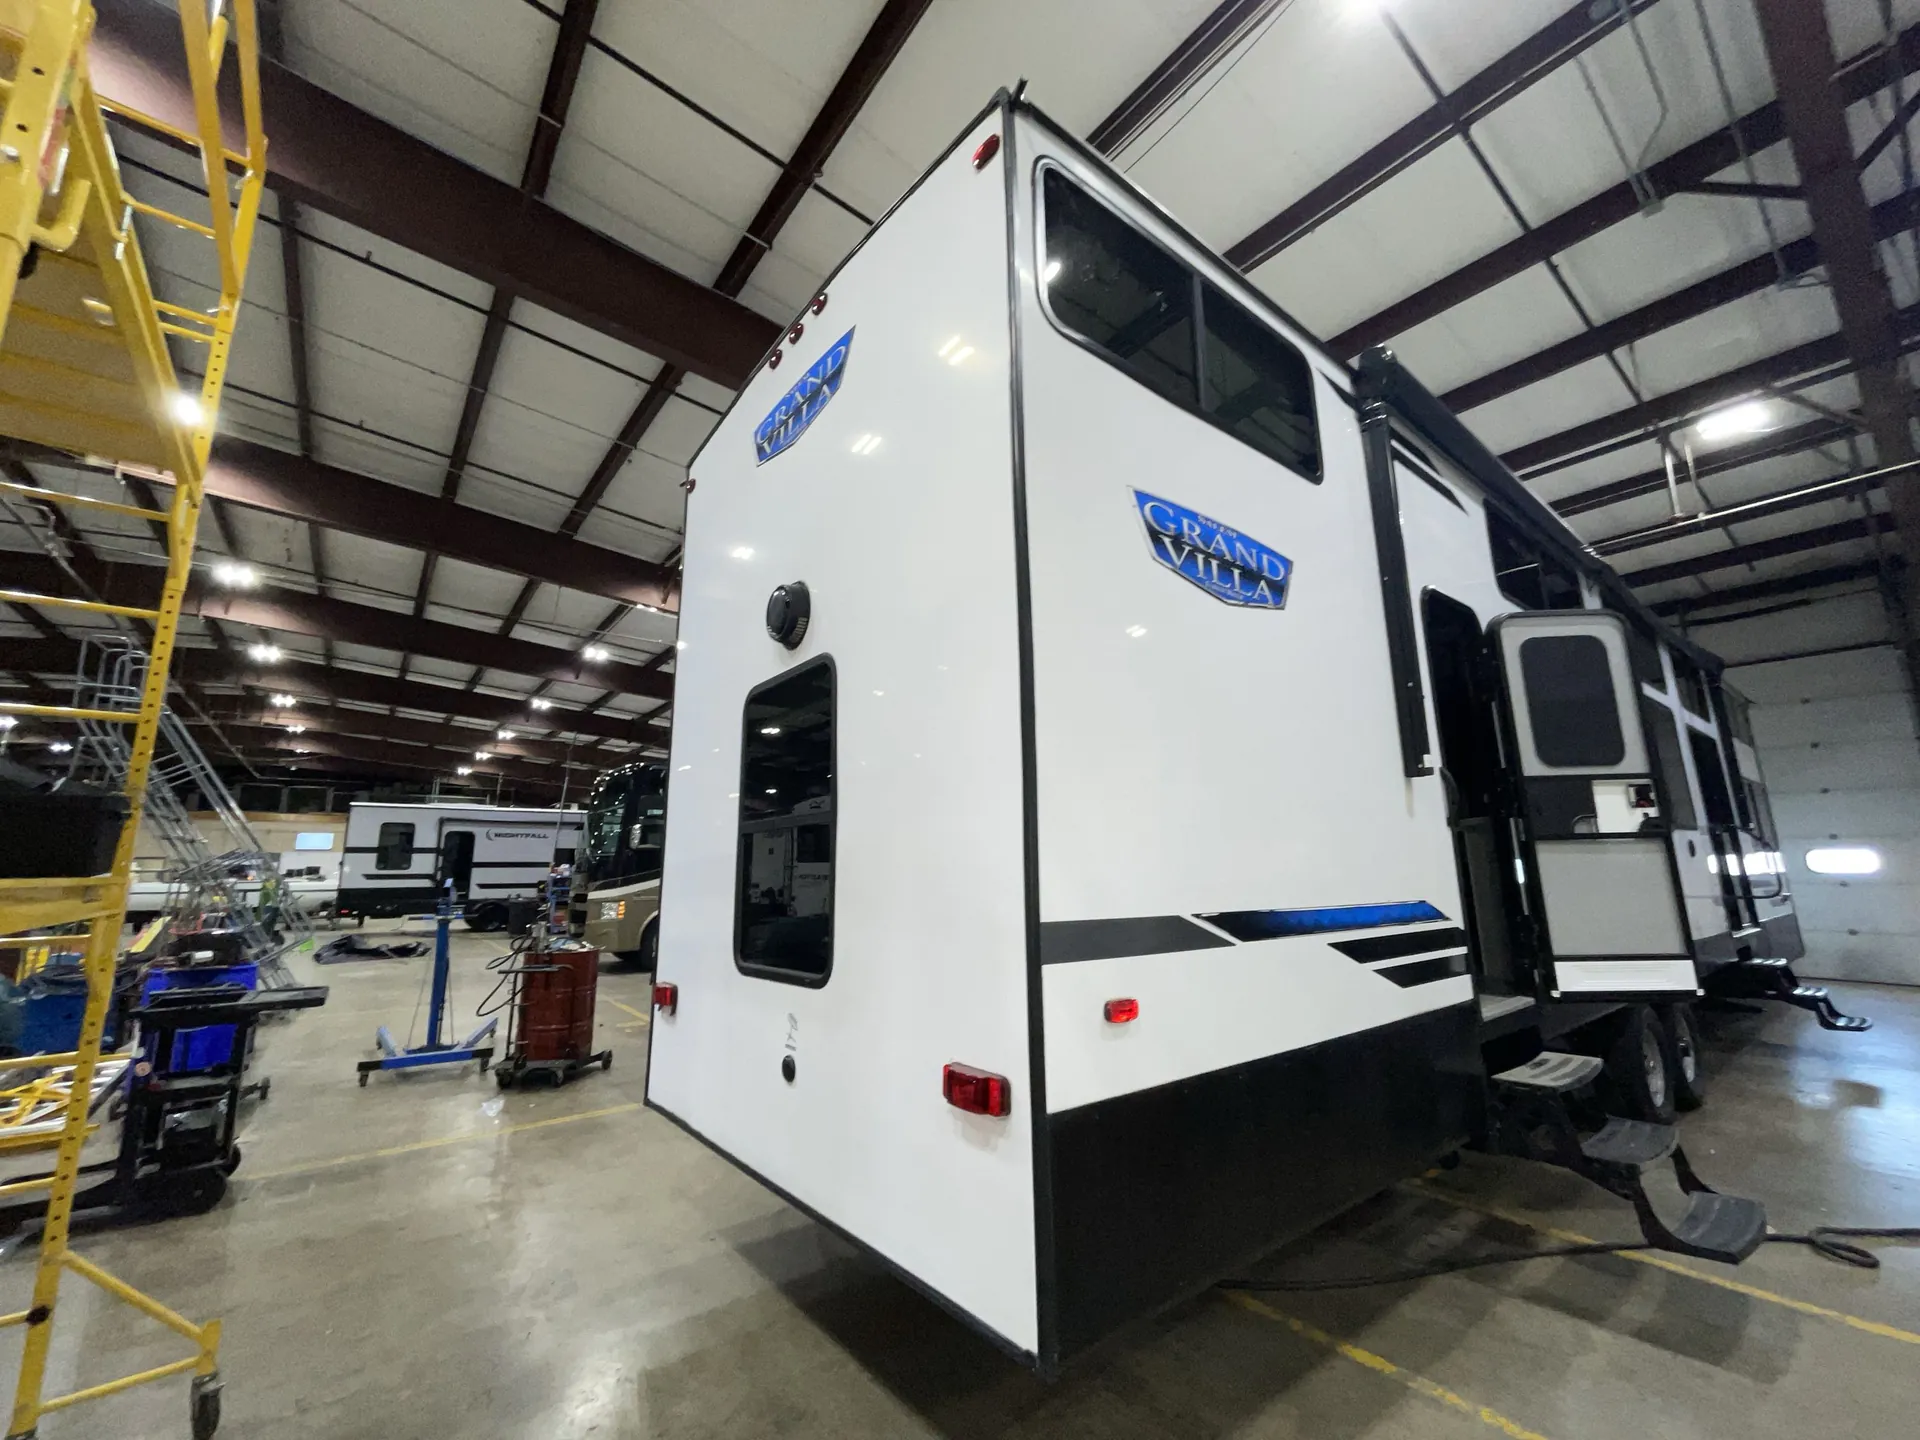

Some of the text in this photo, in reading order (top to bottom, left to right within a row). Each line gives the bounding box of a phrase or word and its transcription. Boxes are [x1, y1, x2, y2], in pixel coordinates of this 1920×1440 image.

[757, 345, 847, 444] GRAND
[762, 383, 832, 454] VILLA
[1143, 501, 1286, 581] GRAND
[1158, 534, 1276, 608] VILLA
[494, 831, 550, 840] NIGHTFALL
